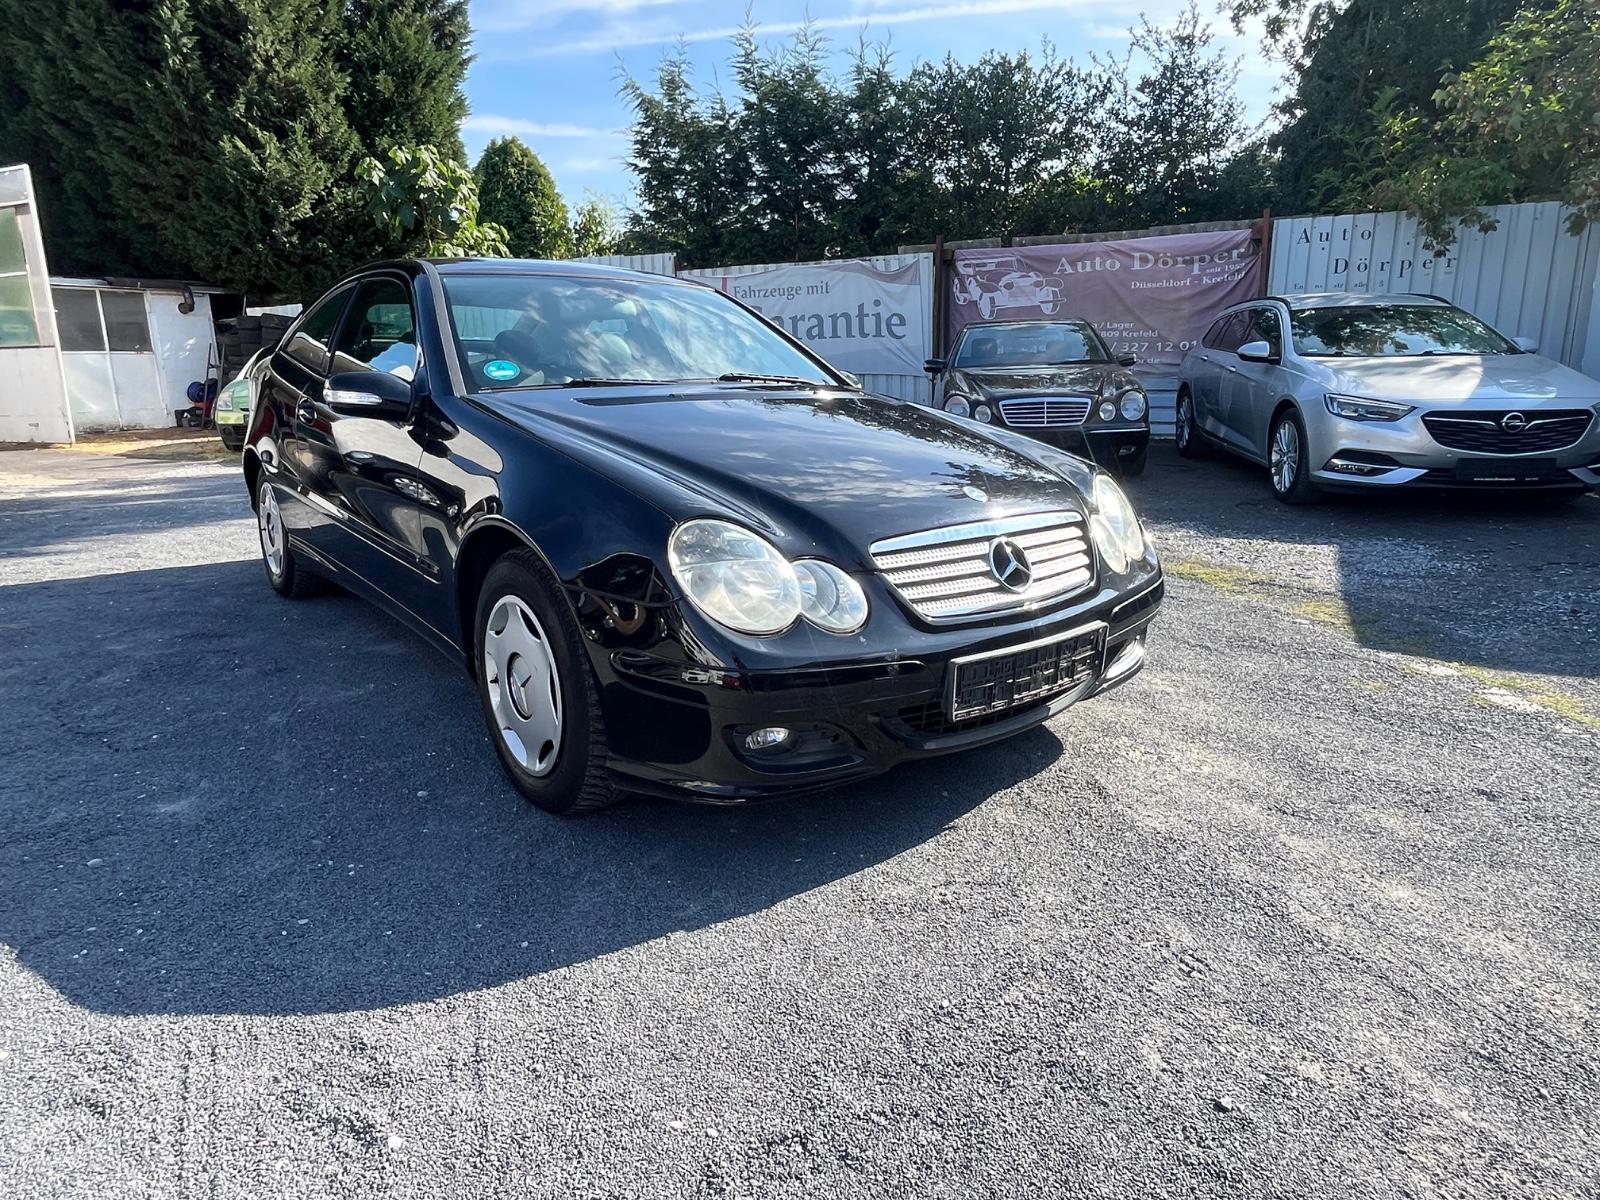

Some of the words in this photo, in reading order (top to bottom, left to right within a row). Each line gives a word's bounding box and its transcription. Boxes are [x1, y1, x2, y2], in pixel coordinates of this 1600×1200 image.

[1296, 227, 1372, 245] Auto
[1053, 256, 1121, 275] Auto
[1130, 248, 1246, 275] Dörper
[1333, 256, 1457, 278] Dörper
[1131, 277, 1192, 289] Düsseldorf
[1202, 271, 1246, 284] Krefeld
[733, 283, 802, 300] Fahrzeuge
[806, 280, 830, 295] mit
[750, 299, 907, 341] rantie
[1107, 321, 1135, 330] Lager
[1122, 329, 1159, 338] Krefeld
[1121, 342, 1149, 352] 327
[1156, 341, 1174, 352] 12
